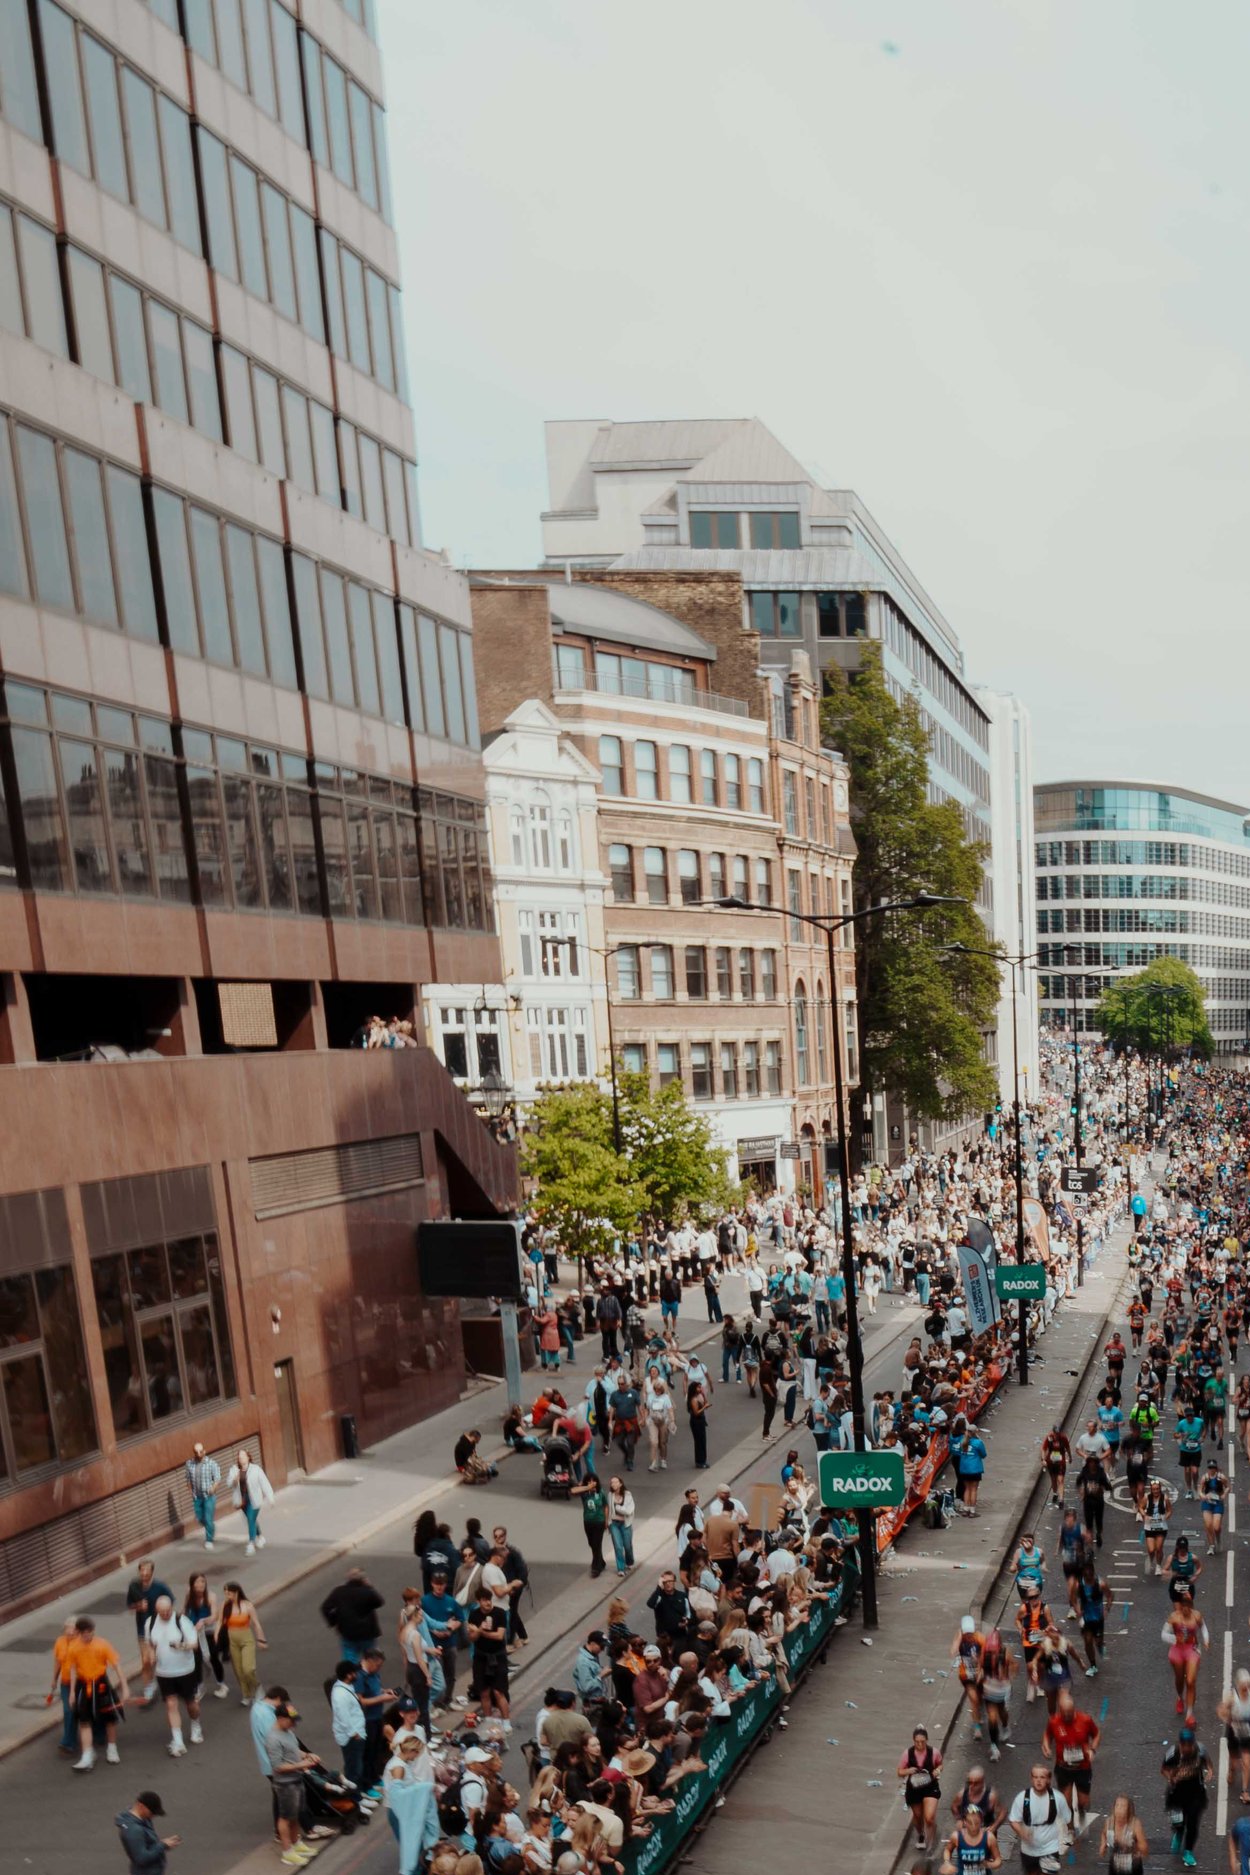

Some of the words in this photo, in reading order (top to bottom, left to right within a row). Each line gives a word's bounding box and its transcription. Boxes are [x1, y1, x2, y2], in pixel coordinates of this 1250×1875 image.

[1002, 1280, 1040, 1291] RADOX
[832, 1477, 893, 1493] RADOX
[676, 1781, 700, 1825] RADOX
